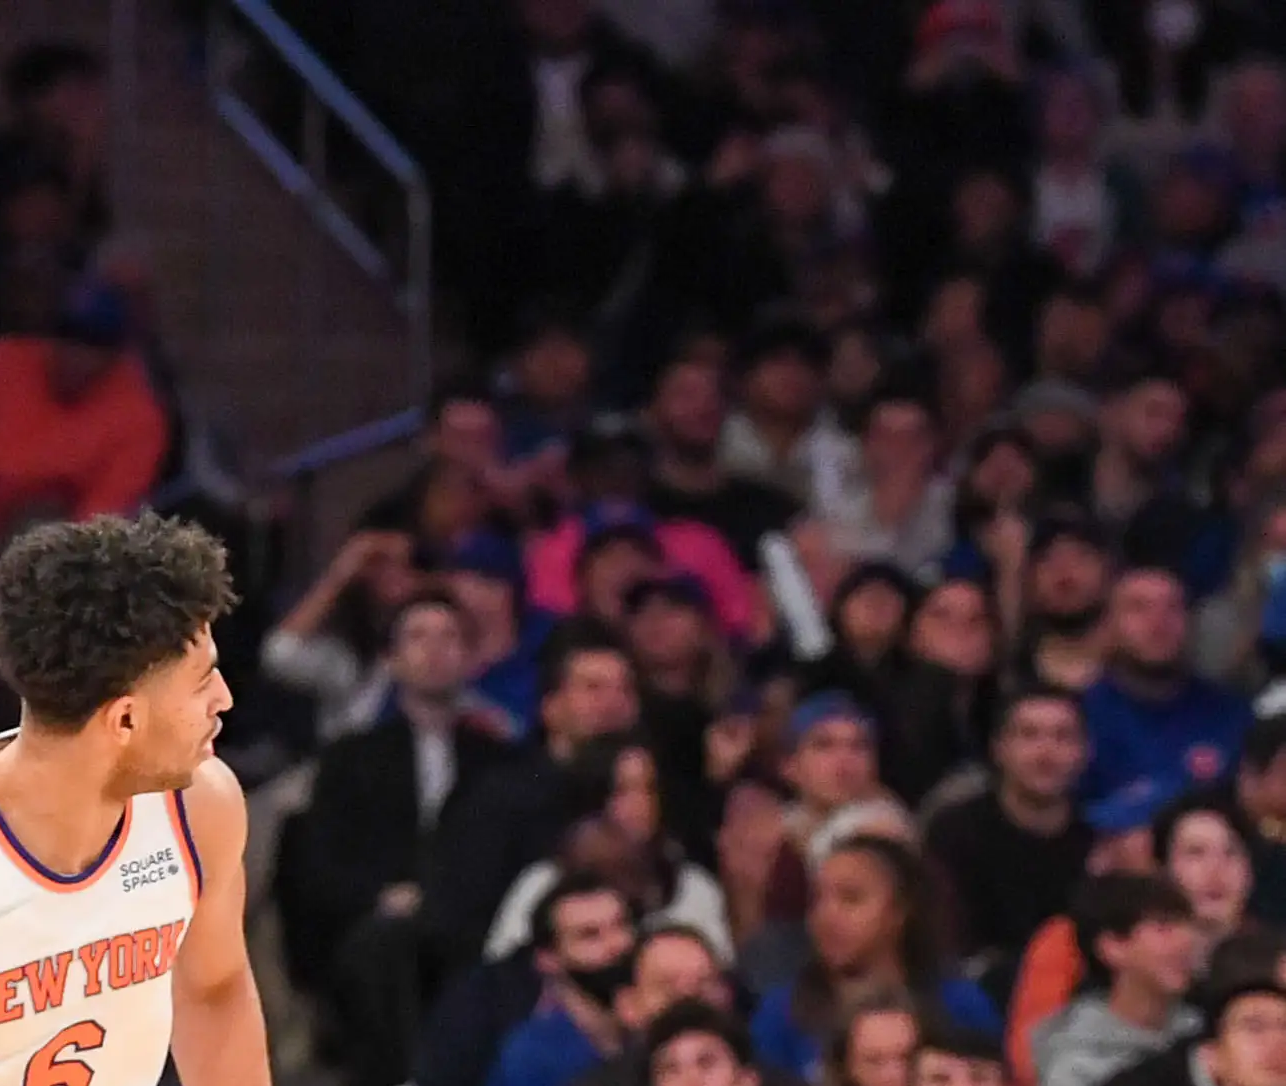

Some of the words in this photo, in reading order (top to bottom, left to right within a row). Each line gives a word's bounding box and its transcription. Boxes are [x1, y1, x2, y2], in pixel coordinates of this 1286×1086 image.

[119, 847, 175, 877] SQUARE
[122, 867, 166, 893] SPACE
[77, 917, 185, 997] YORK
